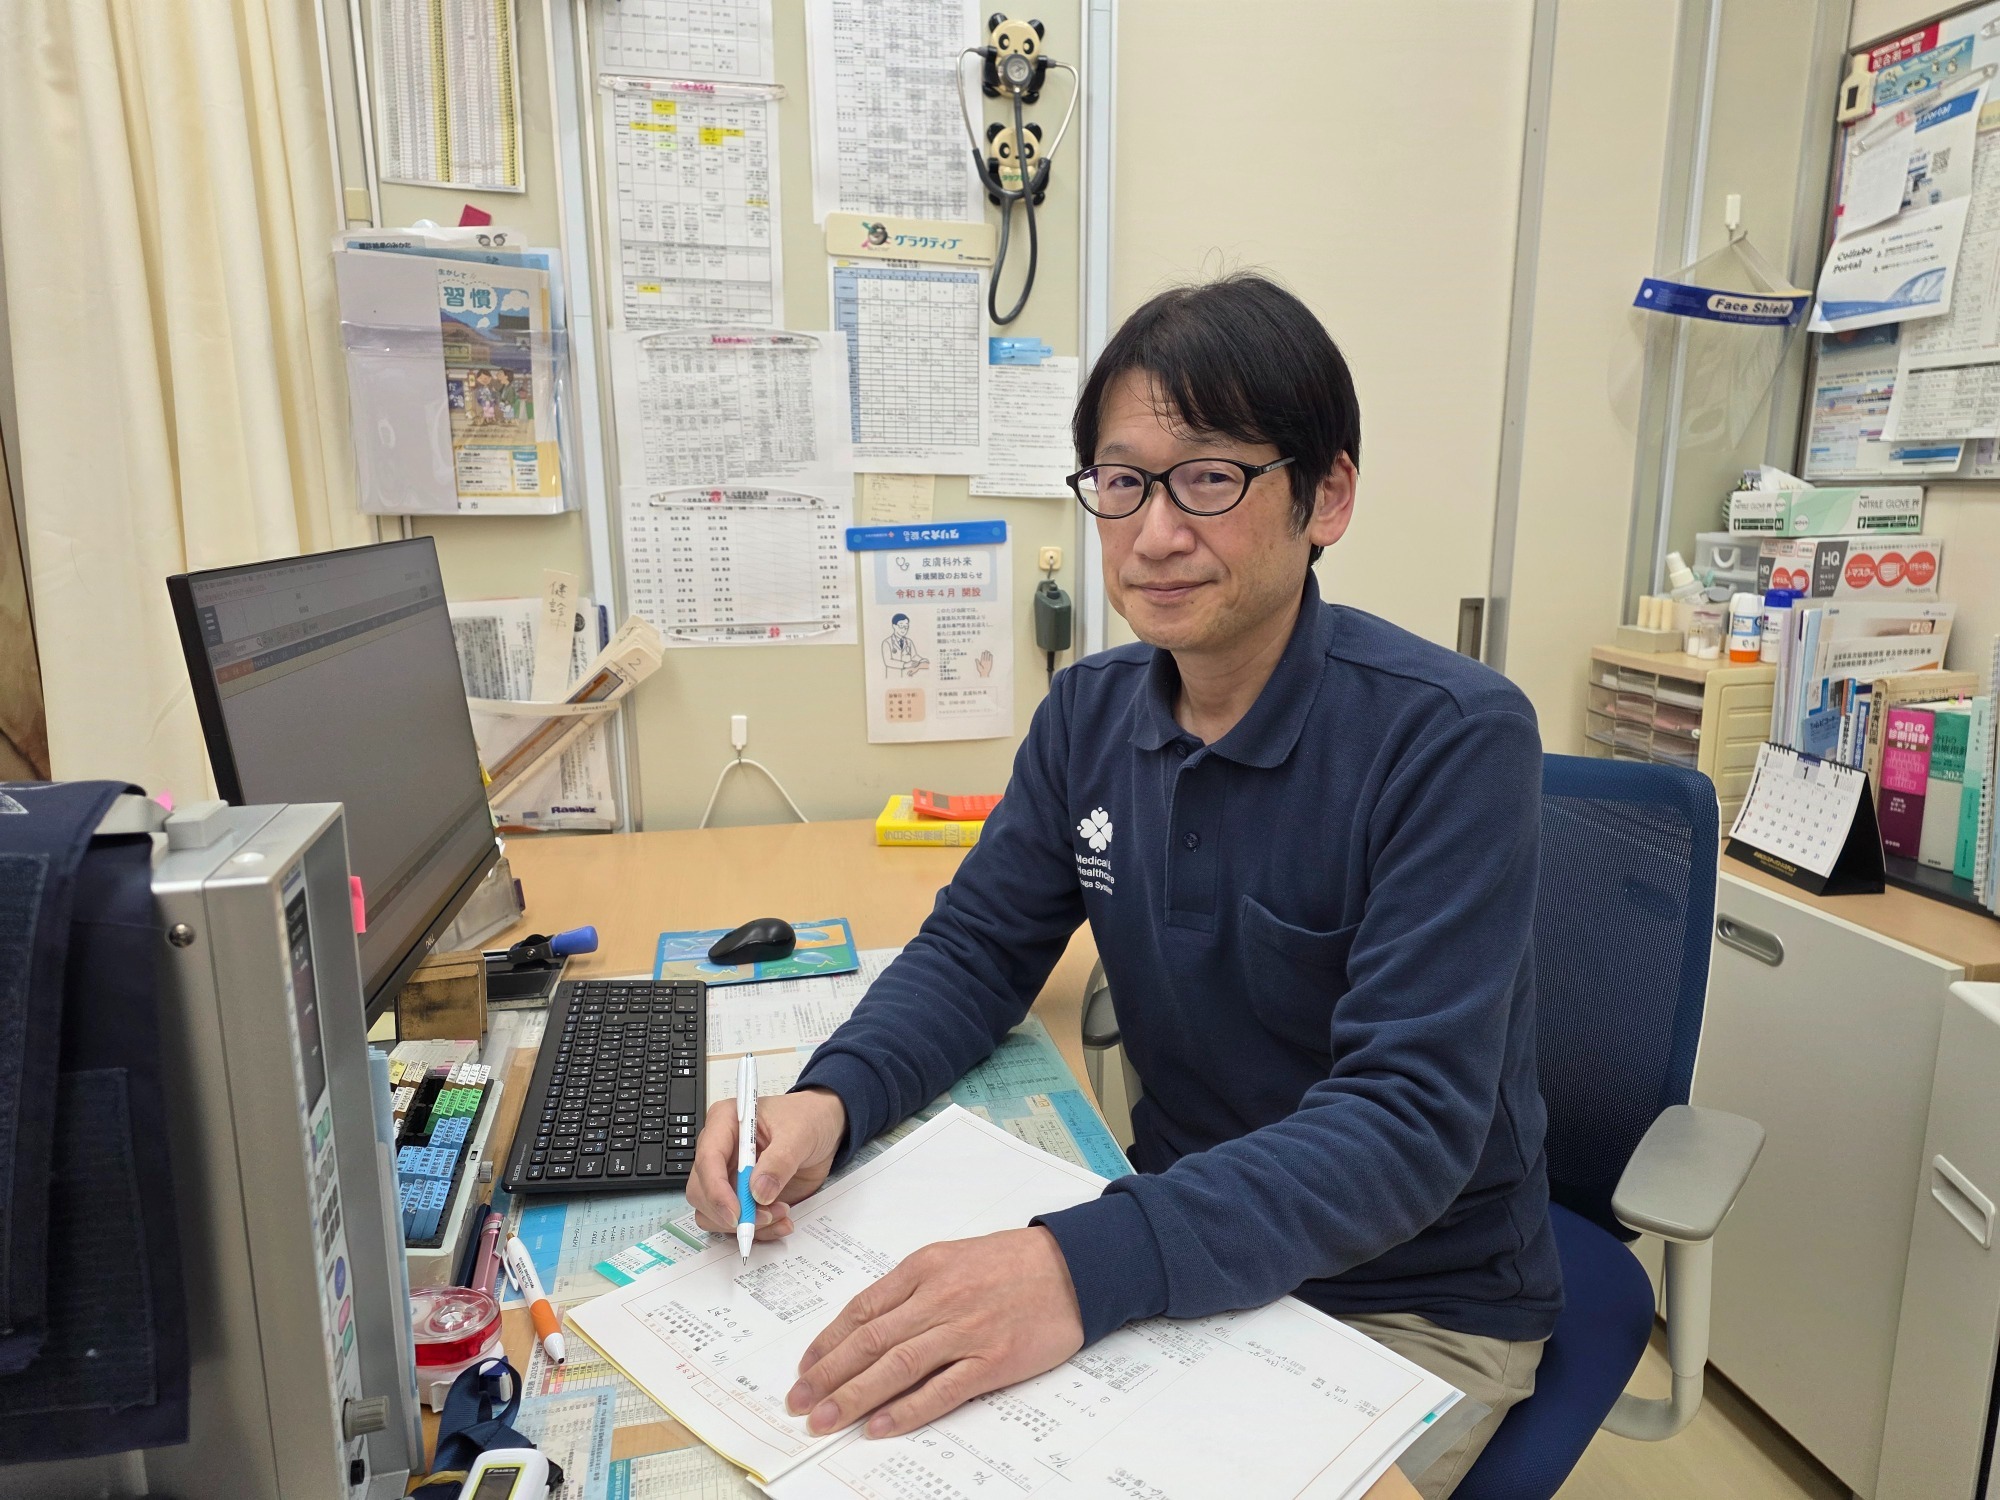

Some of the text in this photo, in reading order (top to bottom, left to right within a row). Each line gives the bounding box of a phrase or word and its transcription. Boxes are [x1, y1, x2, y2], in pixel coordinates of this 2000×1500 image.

[1715, 298, 1790, 315] Face Shield
[1859, 500, 1883, 510] NITRILE
[1885, 498, 1911, 510] GLOVE
[1908, 516, 1918, 527] M
[922, 557, 973, 567] 皮膚科外来
[1821, 551, 1840, 567] HQ
[1760, 564, 1769, 575] HQ
[914, 571, 983, 581] 新規開設のお知らせ
[896, 587, 981, 599] 令和8年4月 開設
[1894, 720, 1926, 733] 今日の
[1889, 728, 1930, 744] 診断指針
[1803, 766, 1809, 779] 1
[551, 806, 597, 814] Rasilez
